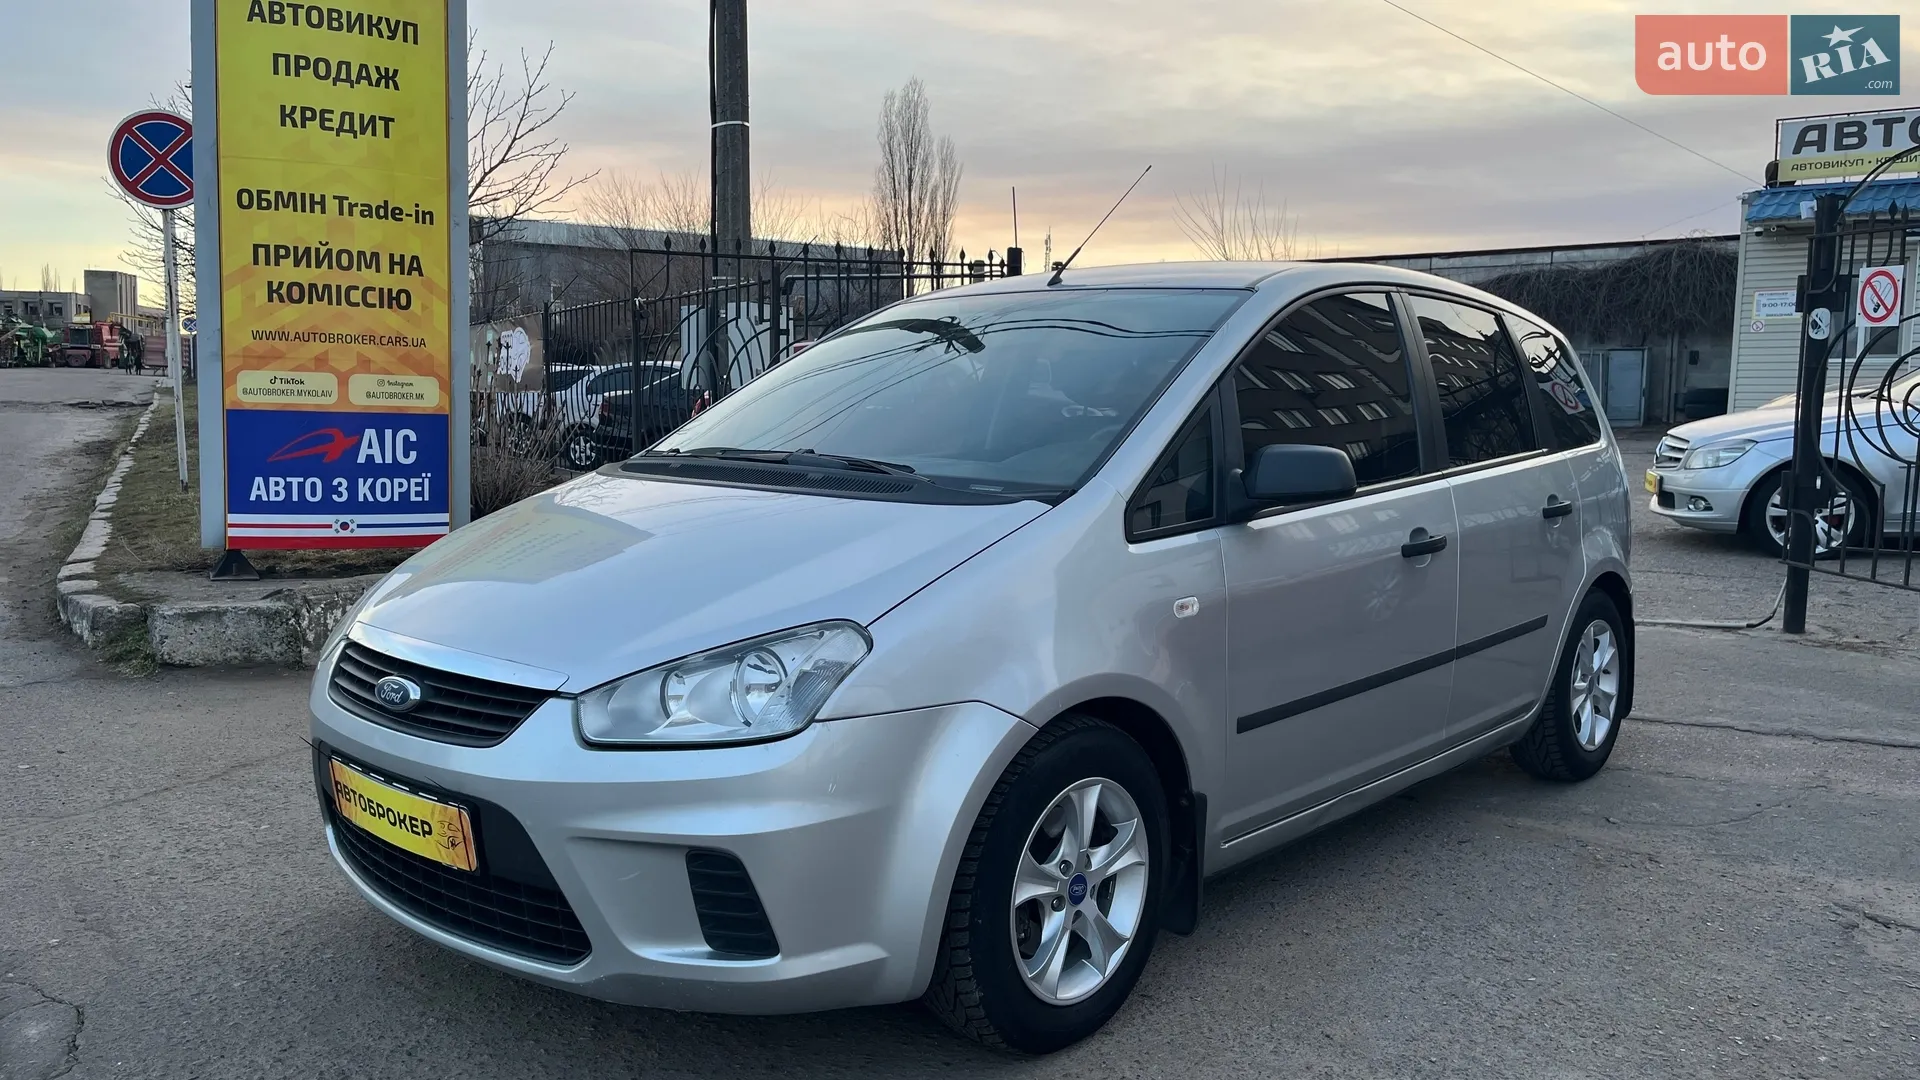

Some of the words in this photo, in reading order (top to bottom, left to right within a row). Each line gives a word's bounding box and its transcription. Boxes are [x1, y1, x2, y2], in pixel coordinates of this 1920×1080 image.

[247, 0, 419, 46] АВТОВИКУП
[272, 52, 400, 91] ПРОДАЖ
[279, 104, 396, 139] КРЕДИТ
[1791, 158, 1864, 171] АВТОВИКУП
[236, 188, 327, 214] ОБМІН
[333, 195, 434, 226] Trade-in
[252, 240, 381, 273] ПРИЙОМ
[388, 252, 424, 277] НА
[267, 280, 412, 311] КОМІССІЮ
[251, 329, 427, 348] WWW.AUTOBROKER.CARS.UA
[242, 387, 333, 399] @AUTOBROKER.MYKOLAIV
[279, 377, 305, 386] TikTok
[365, 391, 425, 401] @AUTOBROKER.MK
[387, 380, 414, 389] Instagram
[249, 476, 323, 503] АВТО
[358, 472, 431, 502] КОРЕЇ
[380, 682, 404, 704] Ford
[335, 780, 433, 838] АВТОБРОКЕР
